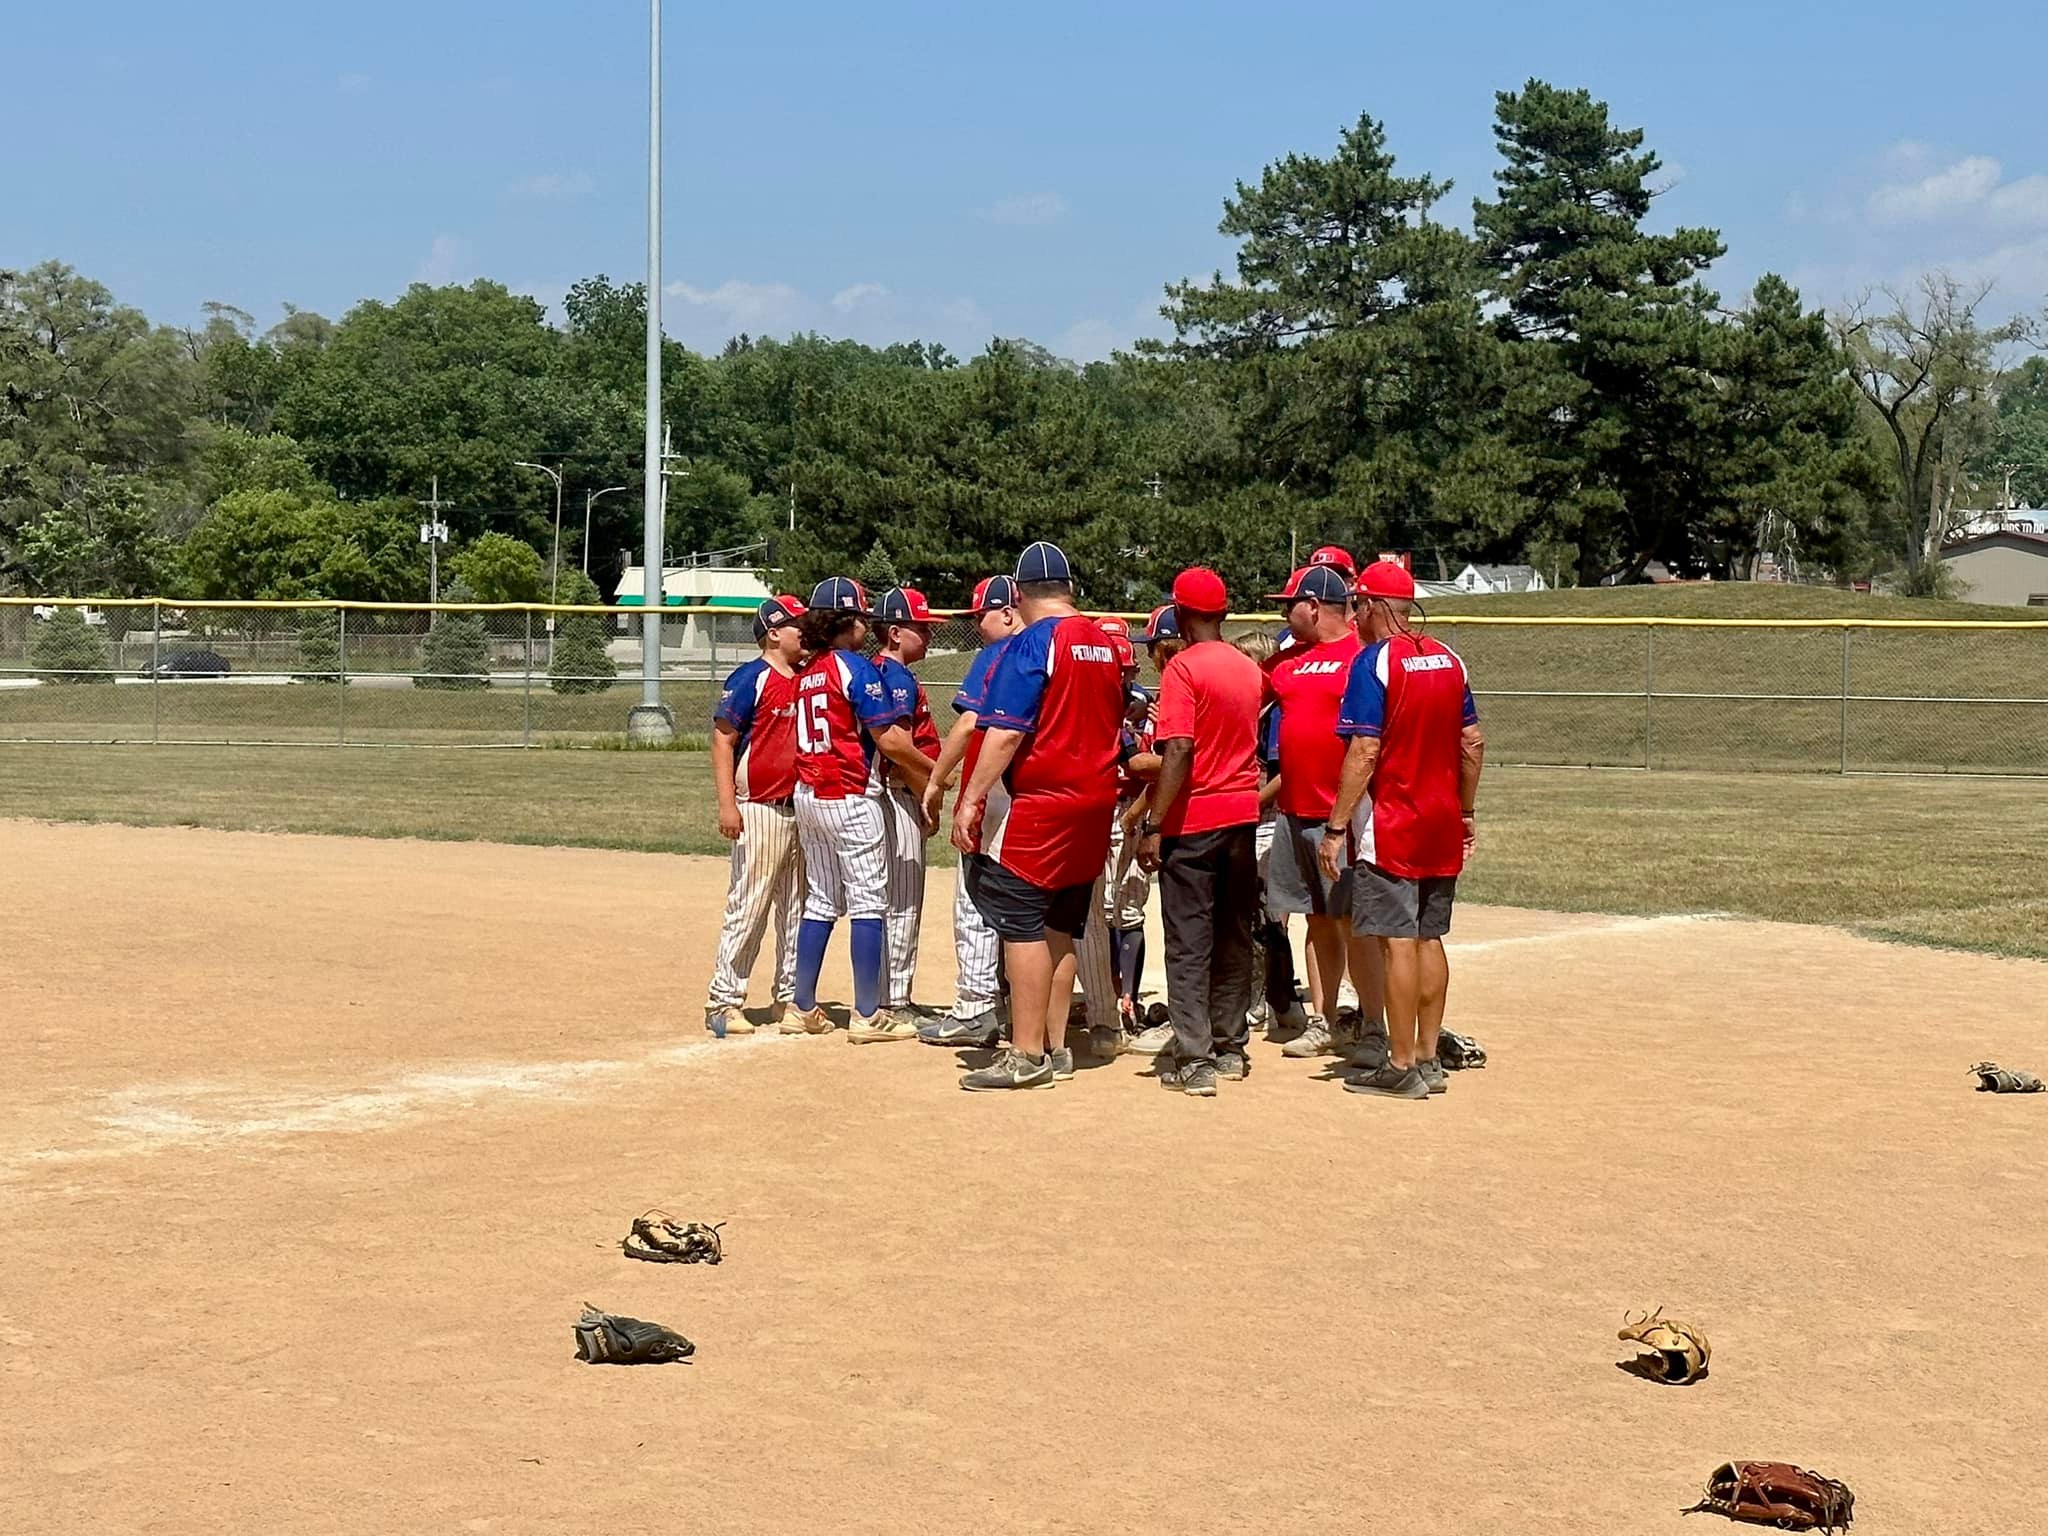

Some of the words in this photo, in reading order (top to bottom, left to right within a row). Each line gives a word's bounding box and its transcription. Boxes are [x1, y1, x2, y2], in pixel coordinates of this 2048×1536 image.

[2021, 522, 2032, 534] TO
[2034, 523, 2045, 534] DO
[1292, 661, 1343, 675] JAM
[797, 693, 832, 755] 15
